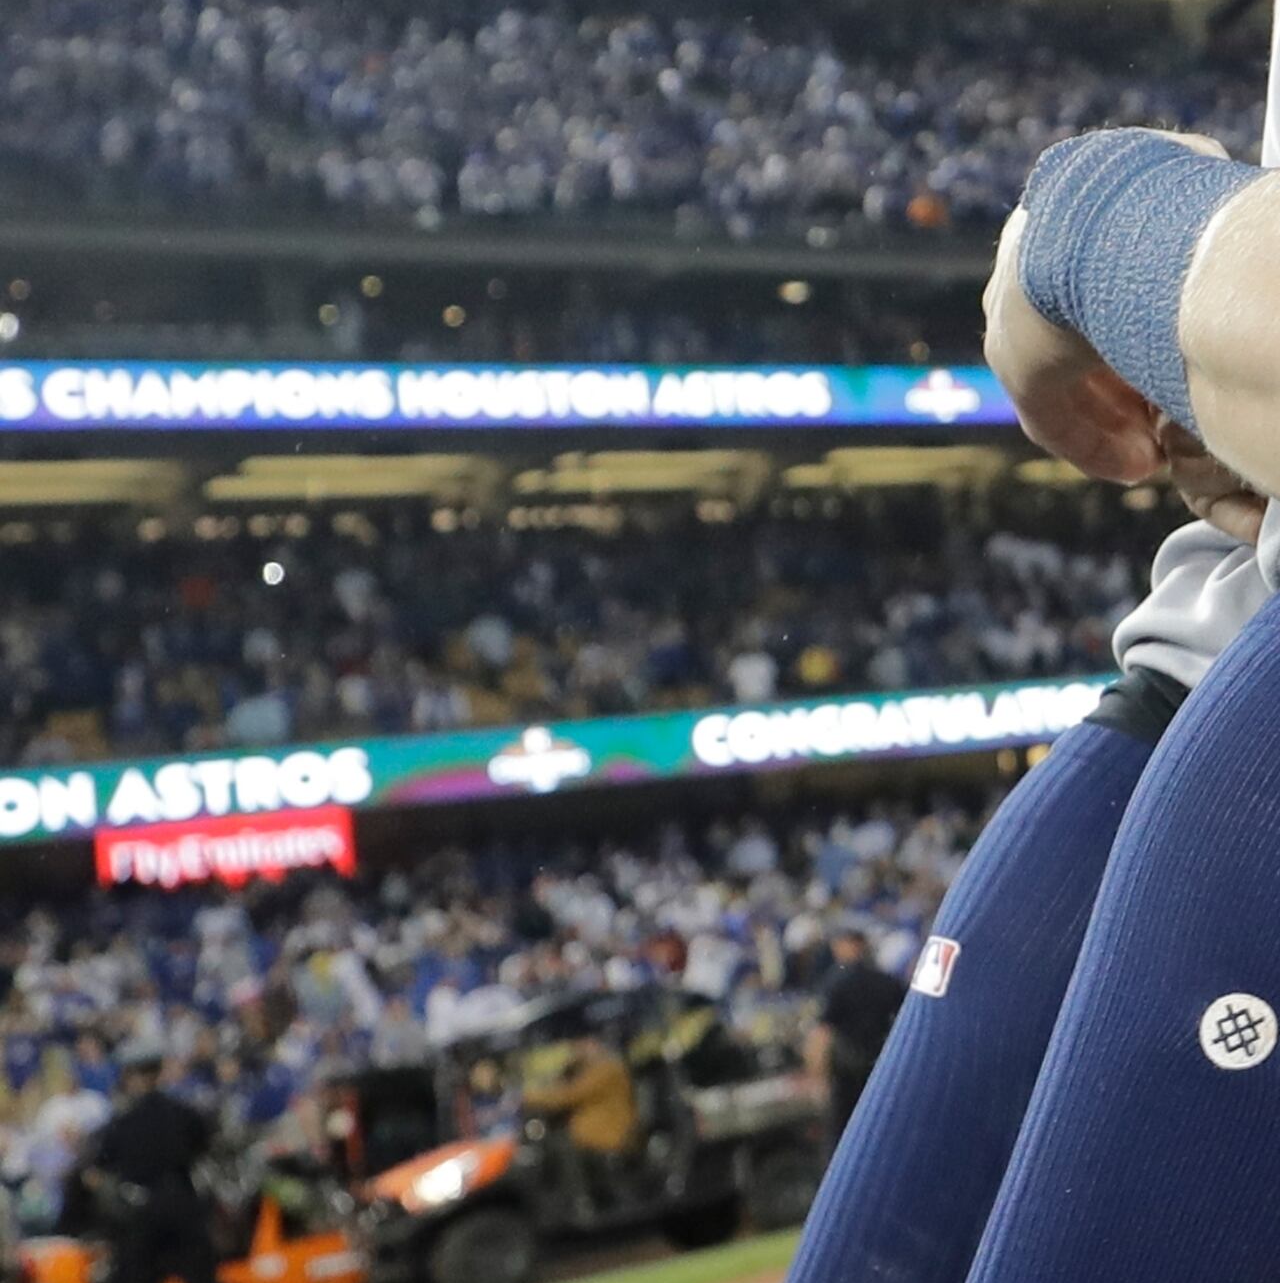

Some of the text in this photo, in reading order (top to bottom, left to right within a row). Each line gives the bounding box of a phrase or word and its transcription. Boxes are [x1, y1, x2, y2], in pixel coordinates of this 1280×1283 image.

[42, 367, 395, 421] CHAMPIONS
[397, 369, 650, 419] HOUSTON
[652, 369, 832, 419] ASTROS
[692, 681, 1106, 766] CONGRATULATIO
[106, 746, 373, 827] ASTROS
